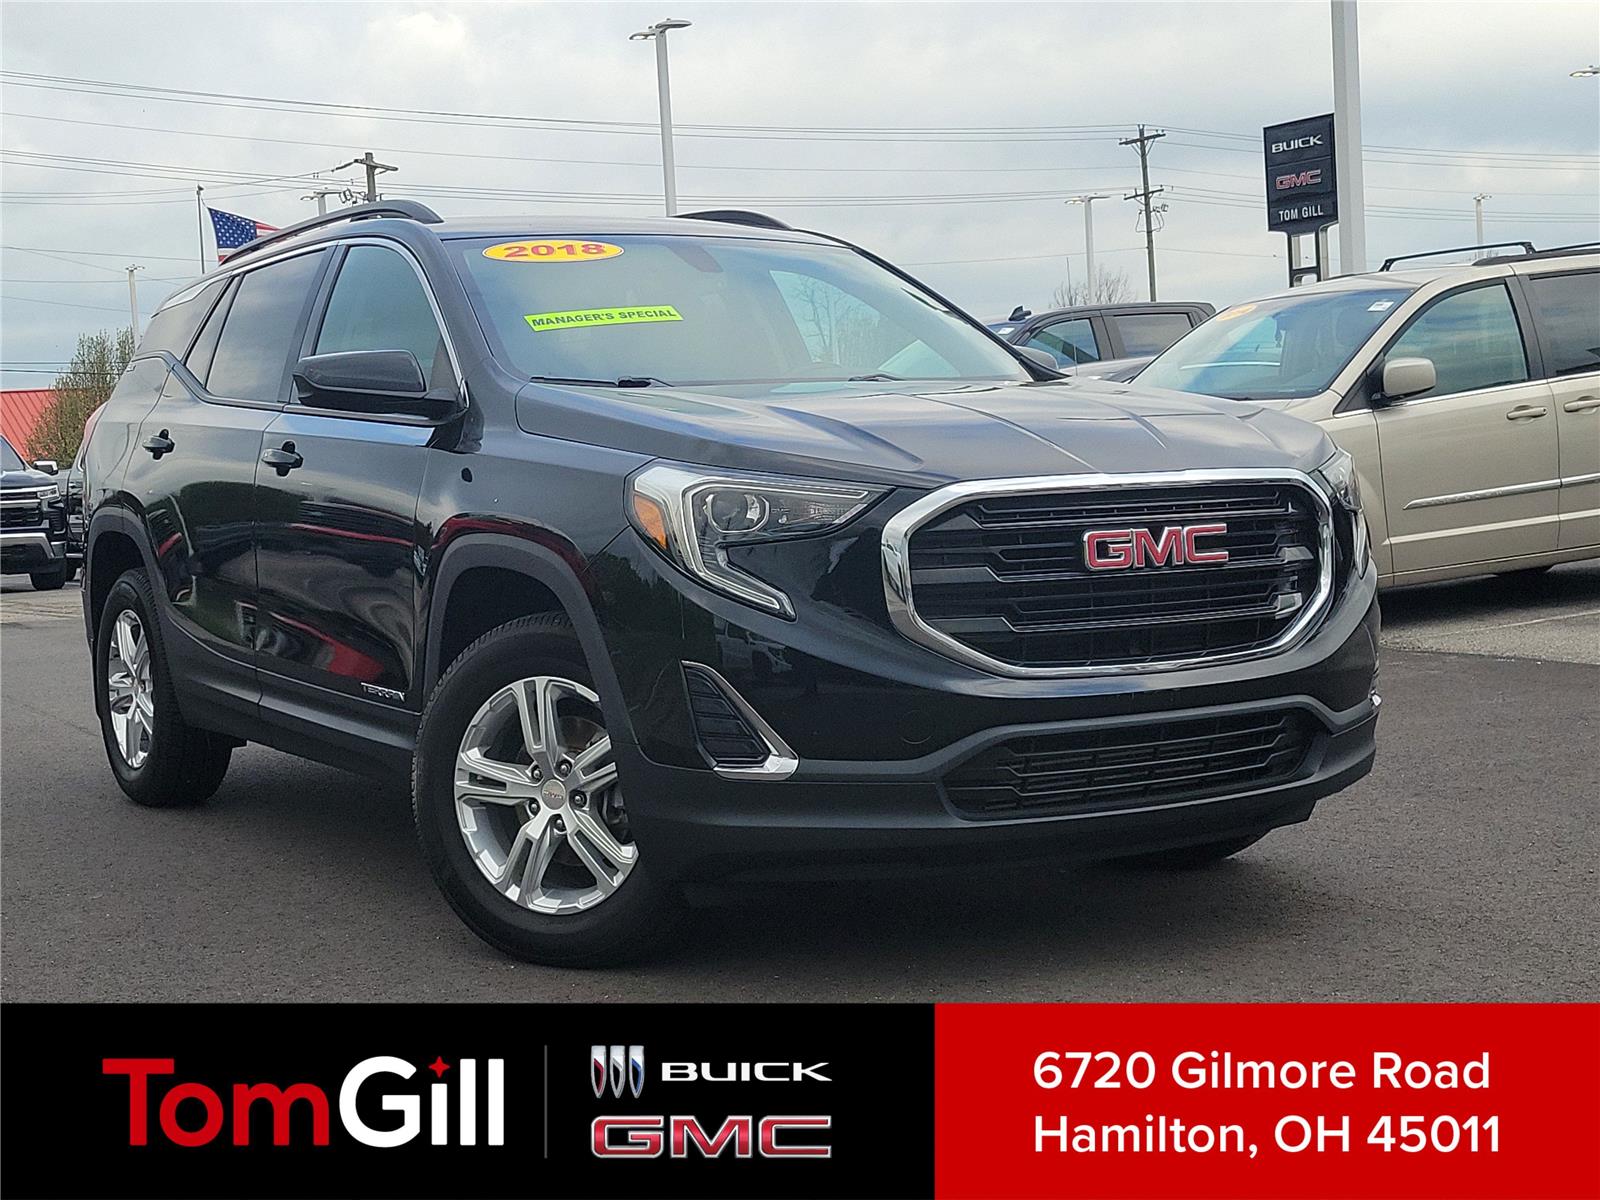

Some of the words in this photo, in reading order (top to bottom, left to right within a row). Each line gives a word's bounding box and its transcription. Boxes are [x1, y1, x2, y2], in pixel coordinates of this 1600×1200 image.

[1271, 134, 1324, 154] BUICK
[1275, 169, 1322, 190] GMC
[1279, 207, 1299, 222] TOM
[1301, 204, 1324, 219] GILL
[503, 243, 606, 258] 2018
[531, 311, 615, 327] MANAGER'S
[617, 309, 677, 320] SPECIAL
[1083, 523, 1229, 571] GMC
